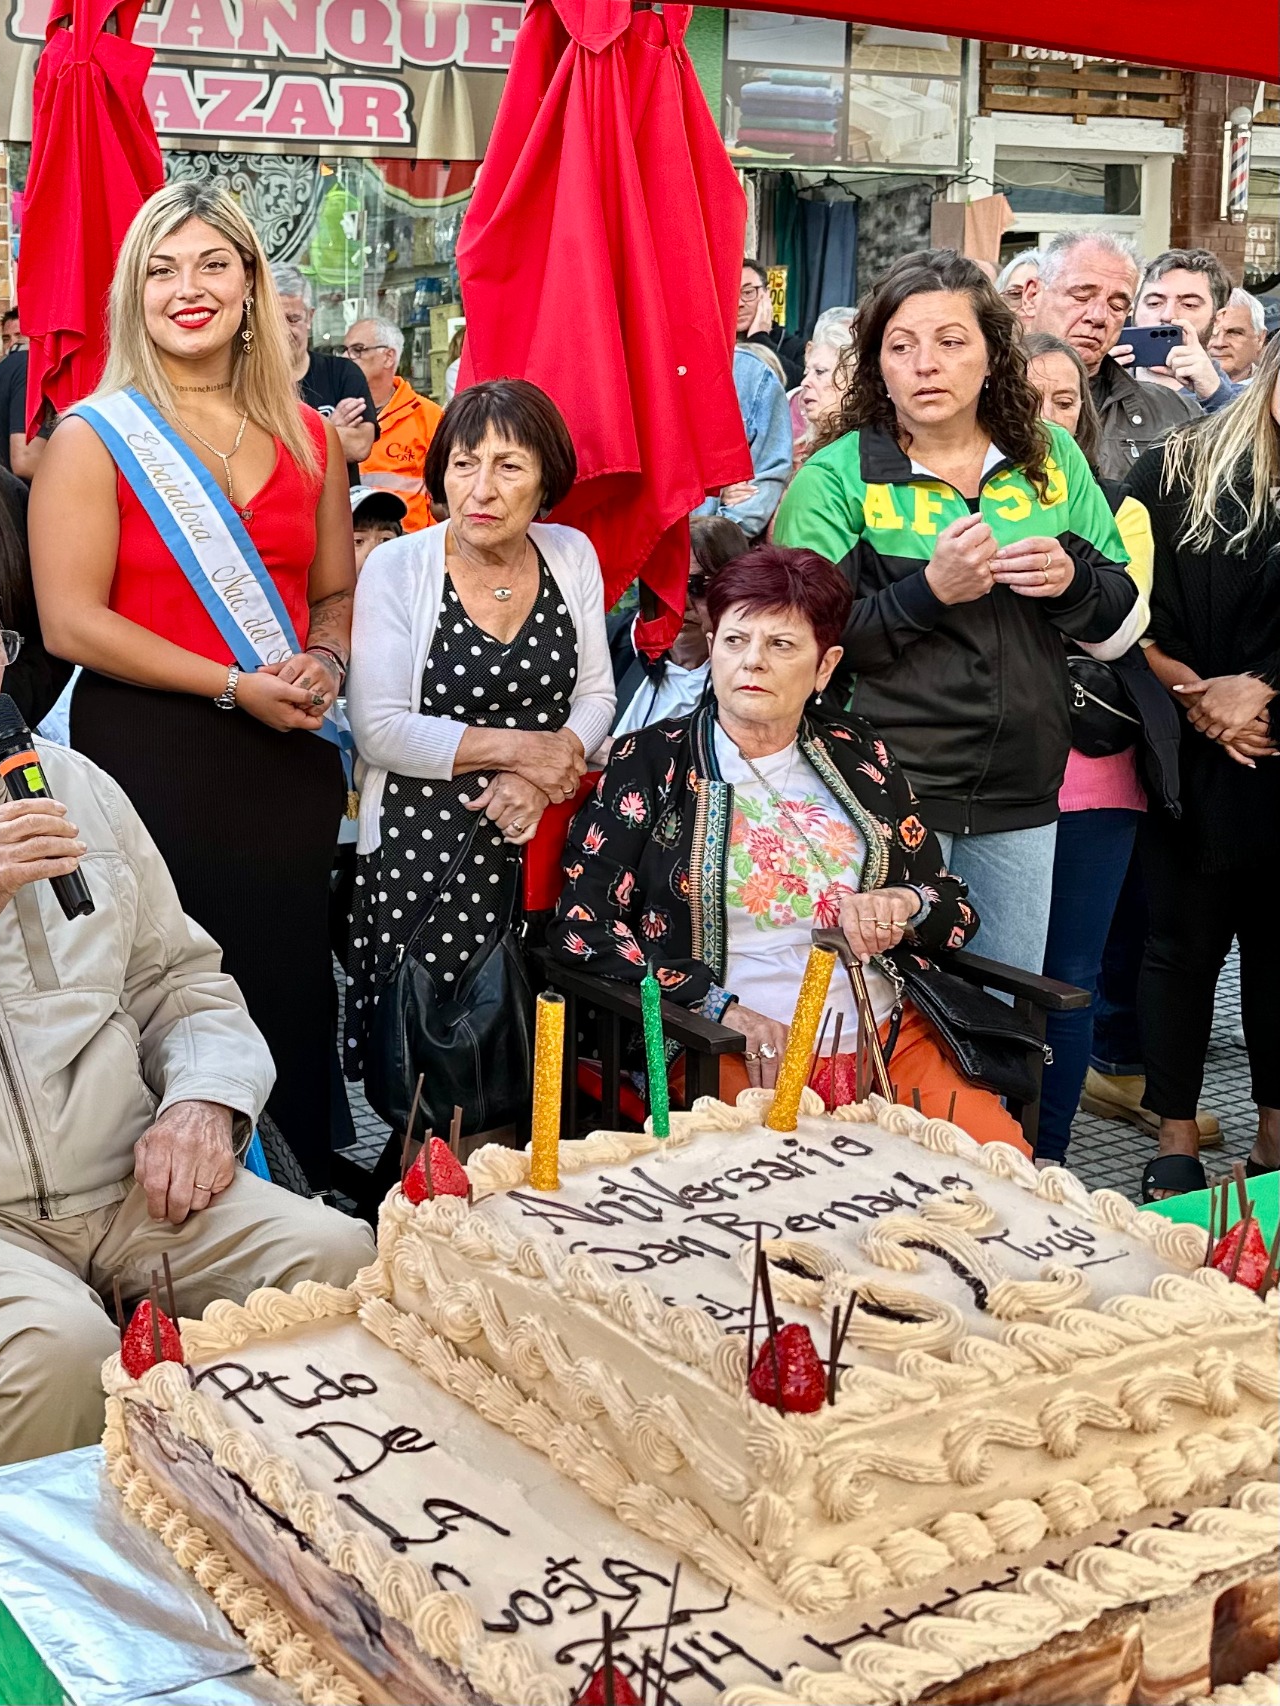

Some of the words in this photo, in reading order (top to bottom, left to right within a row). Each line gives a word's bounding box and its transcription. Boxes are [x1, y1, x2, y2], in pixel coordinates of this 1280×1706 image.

[143, 72, 411, 141] AZAR
[127, 430, 212, 544] Embajadora
[211, 565, 259, 613] Nac.
[242, 618, 281, 645] del
[295, 1421, 438, 1482] De
